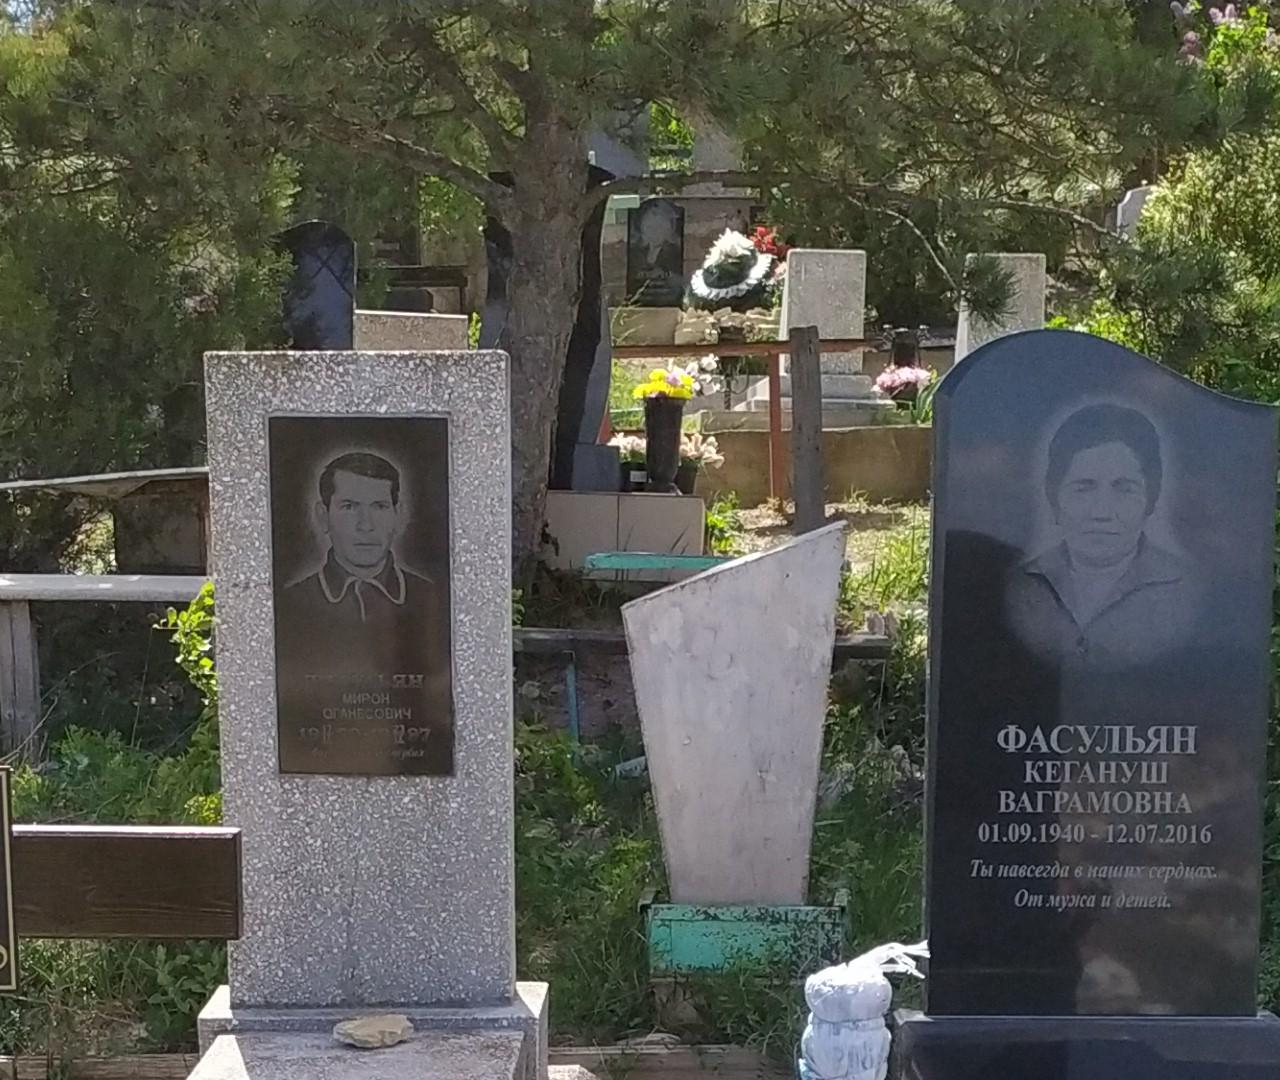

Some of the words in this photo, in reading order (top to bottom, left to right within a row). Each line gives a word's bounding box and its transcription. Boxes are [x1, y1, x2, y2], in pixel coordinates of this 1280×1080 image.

[996, 724, 1198, 754] ФАСУЛЬЯН
[1023, 760, 1168, 784] КЕГАНУШ
[997, 790, 1193, 814] ВАГРАМОВНА
[977, 822, 1085, 844] 01.09.1940
[1106, 824, 1212, 844] 12.07.2016
[969, 859, 993, 878] Ты
[997, 860, 1070, 878] навсегда
[1074, 866, 1082, 878] в
[1087, 865, 1143, 879] наших
[1014, 889, 1043, 908] От
[1046, 893, 1095, 912] мужа
[1101, 895, 1110, 908] и
[1116, 890, 1172, 909] детей.
